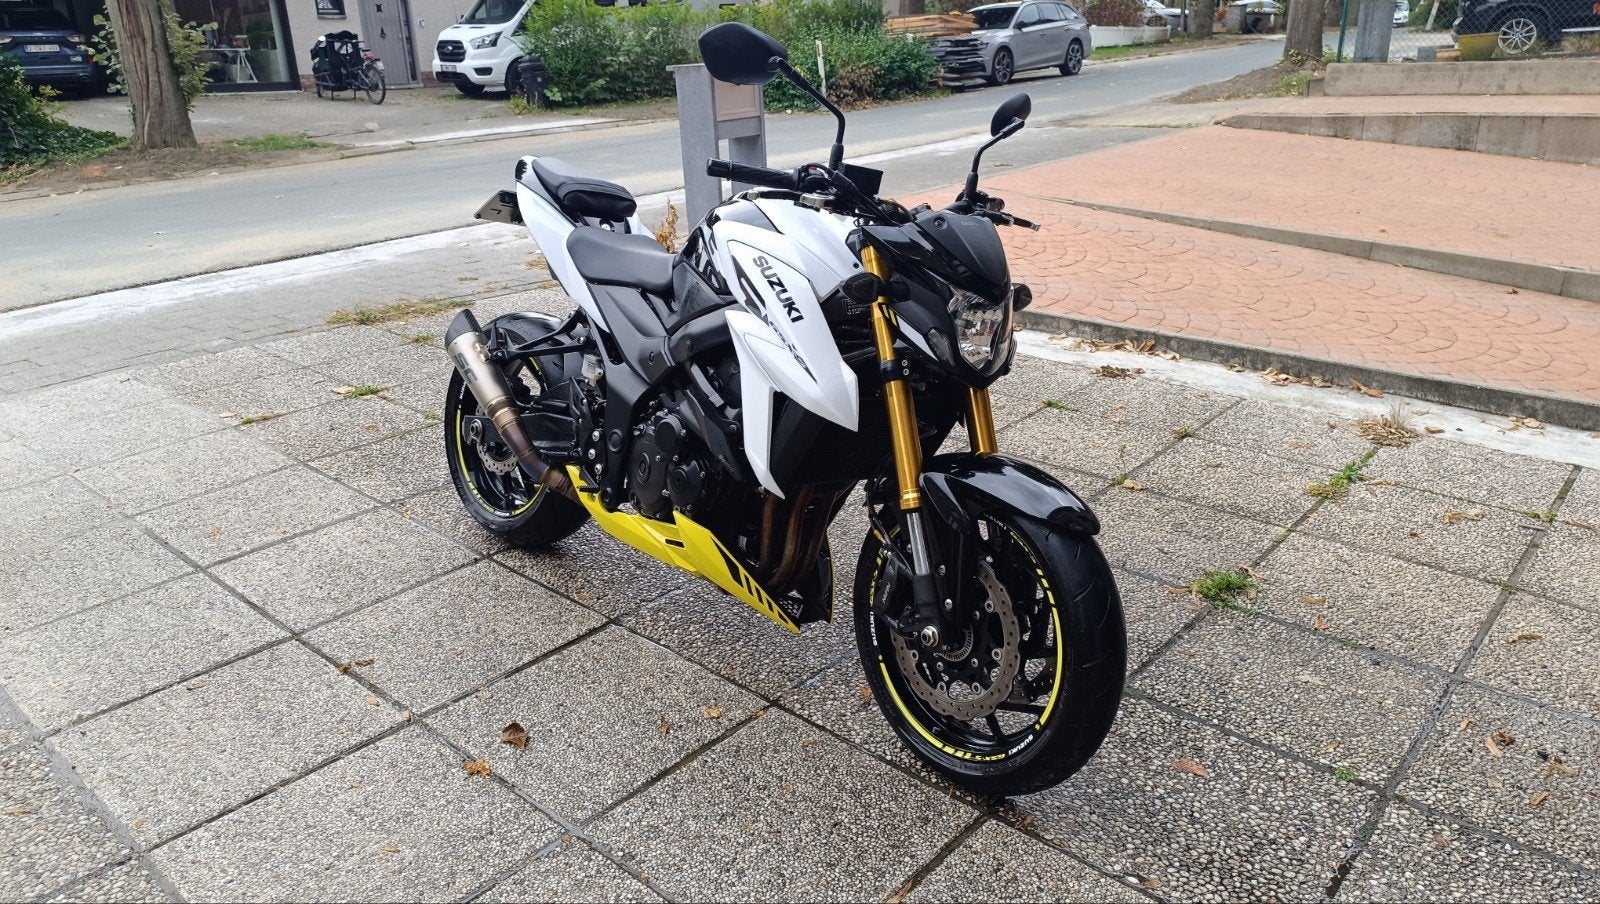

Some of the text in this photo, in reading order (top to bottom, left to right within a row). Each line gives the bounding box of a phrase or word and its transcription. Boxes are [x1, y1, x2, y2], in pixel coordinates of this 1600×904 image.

[753, 255, 805, 324] SUZUKI
[869, 611, 878, 647] SUZUKI
[1008, 734, 1034, 756] SUZUKI
